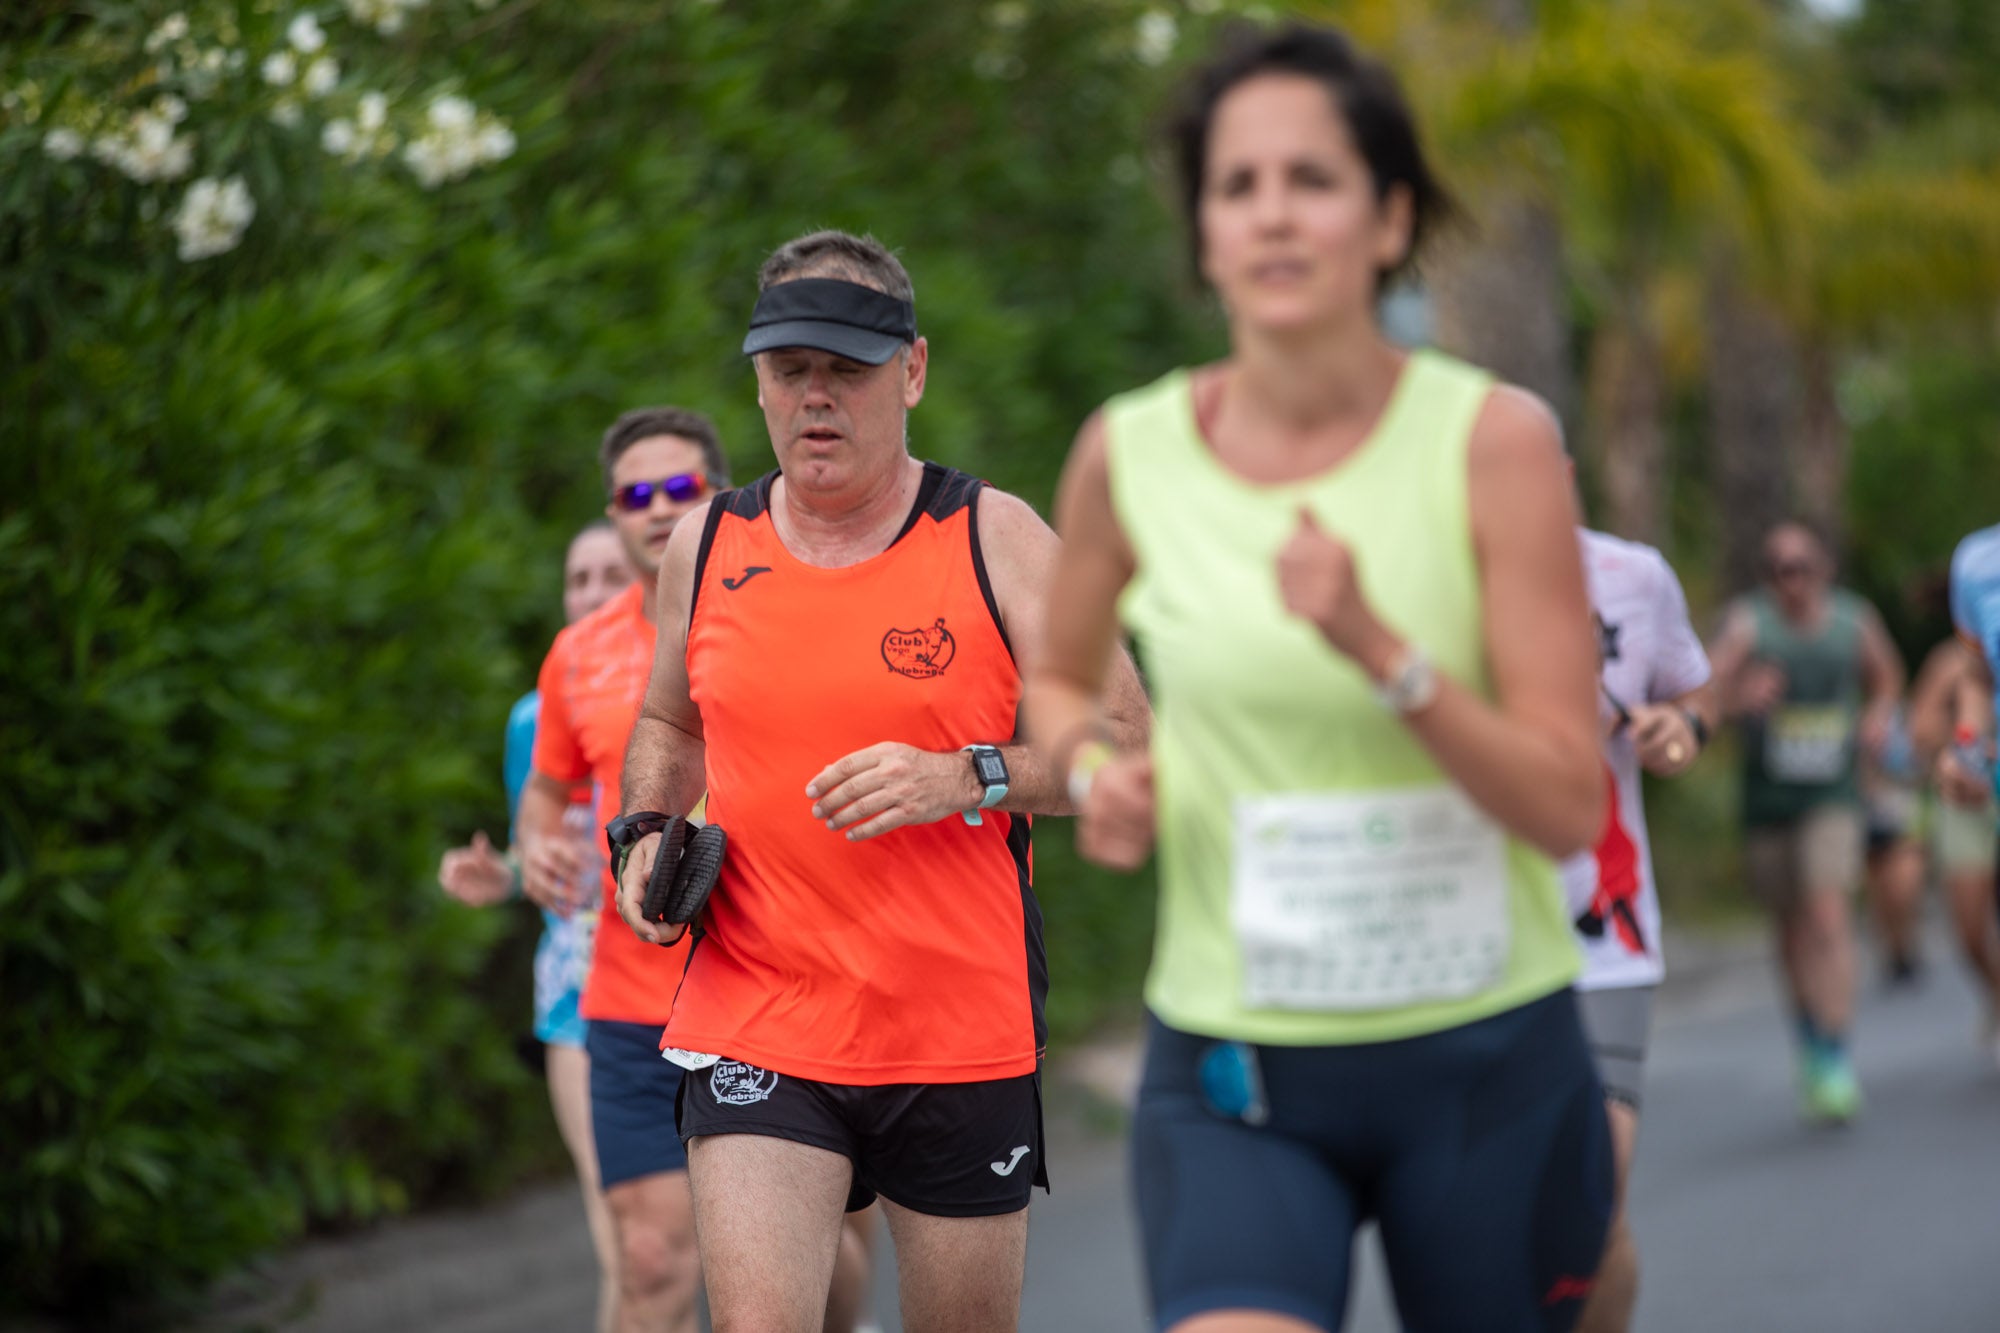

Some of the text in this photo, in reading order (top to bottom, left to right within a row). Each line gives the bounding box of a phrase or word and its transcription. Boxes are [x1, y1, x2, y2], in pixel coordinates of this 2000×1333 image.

[889, 636, 922, 646] Club
[887, 646, 910, 654] Vega
[716, 1065, 746, 1077] Club
[715, 1076, 735, 1084] Vega
